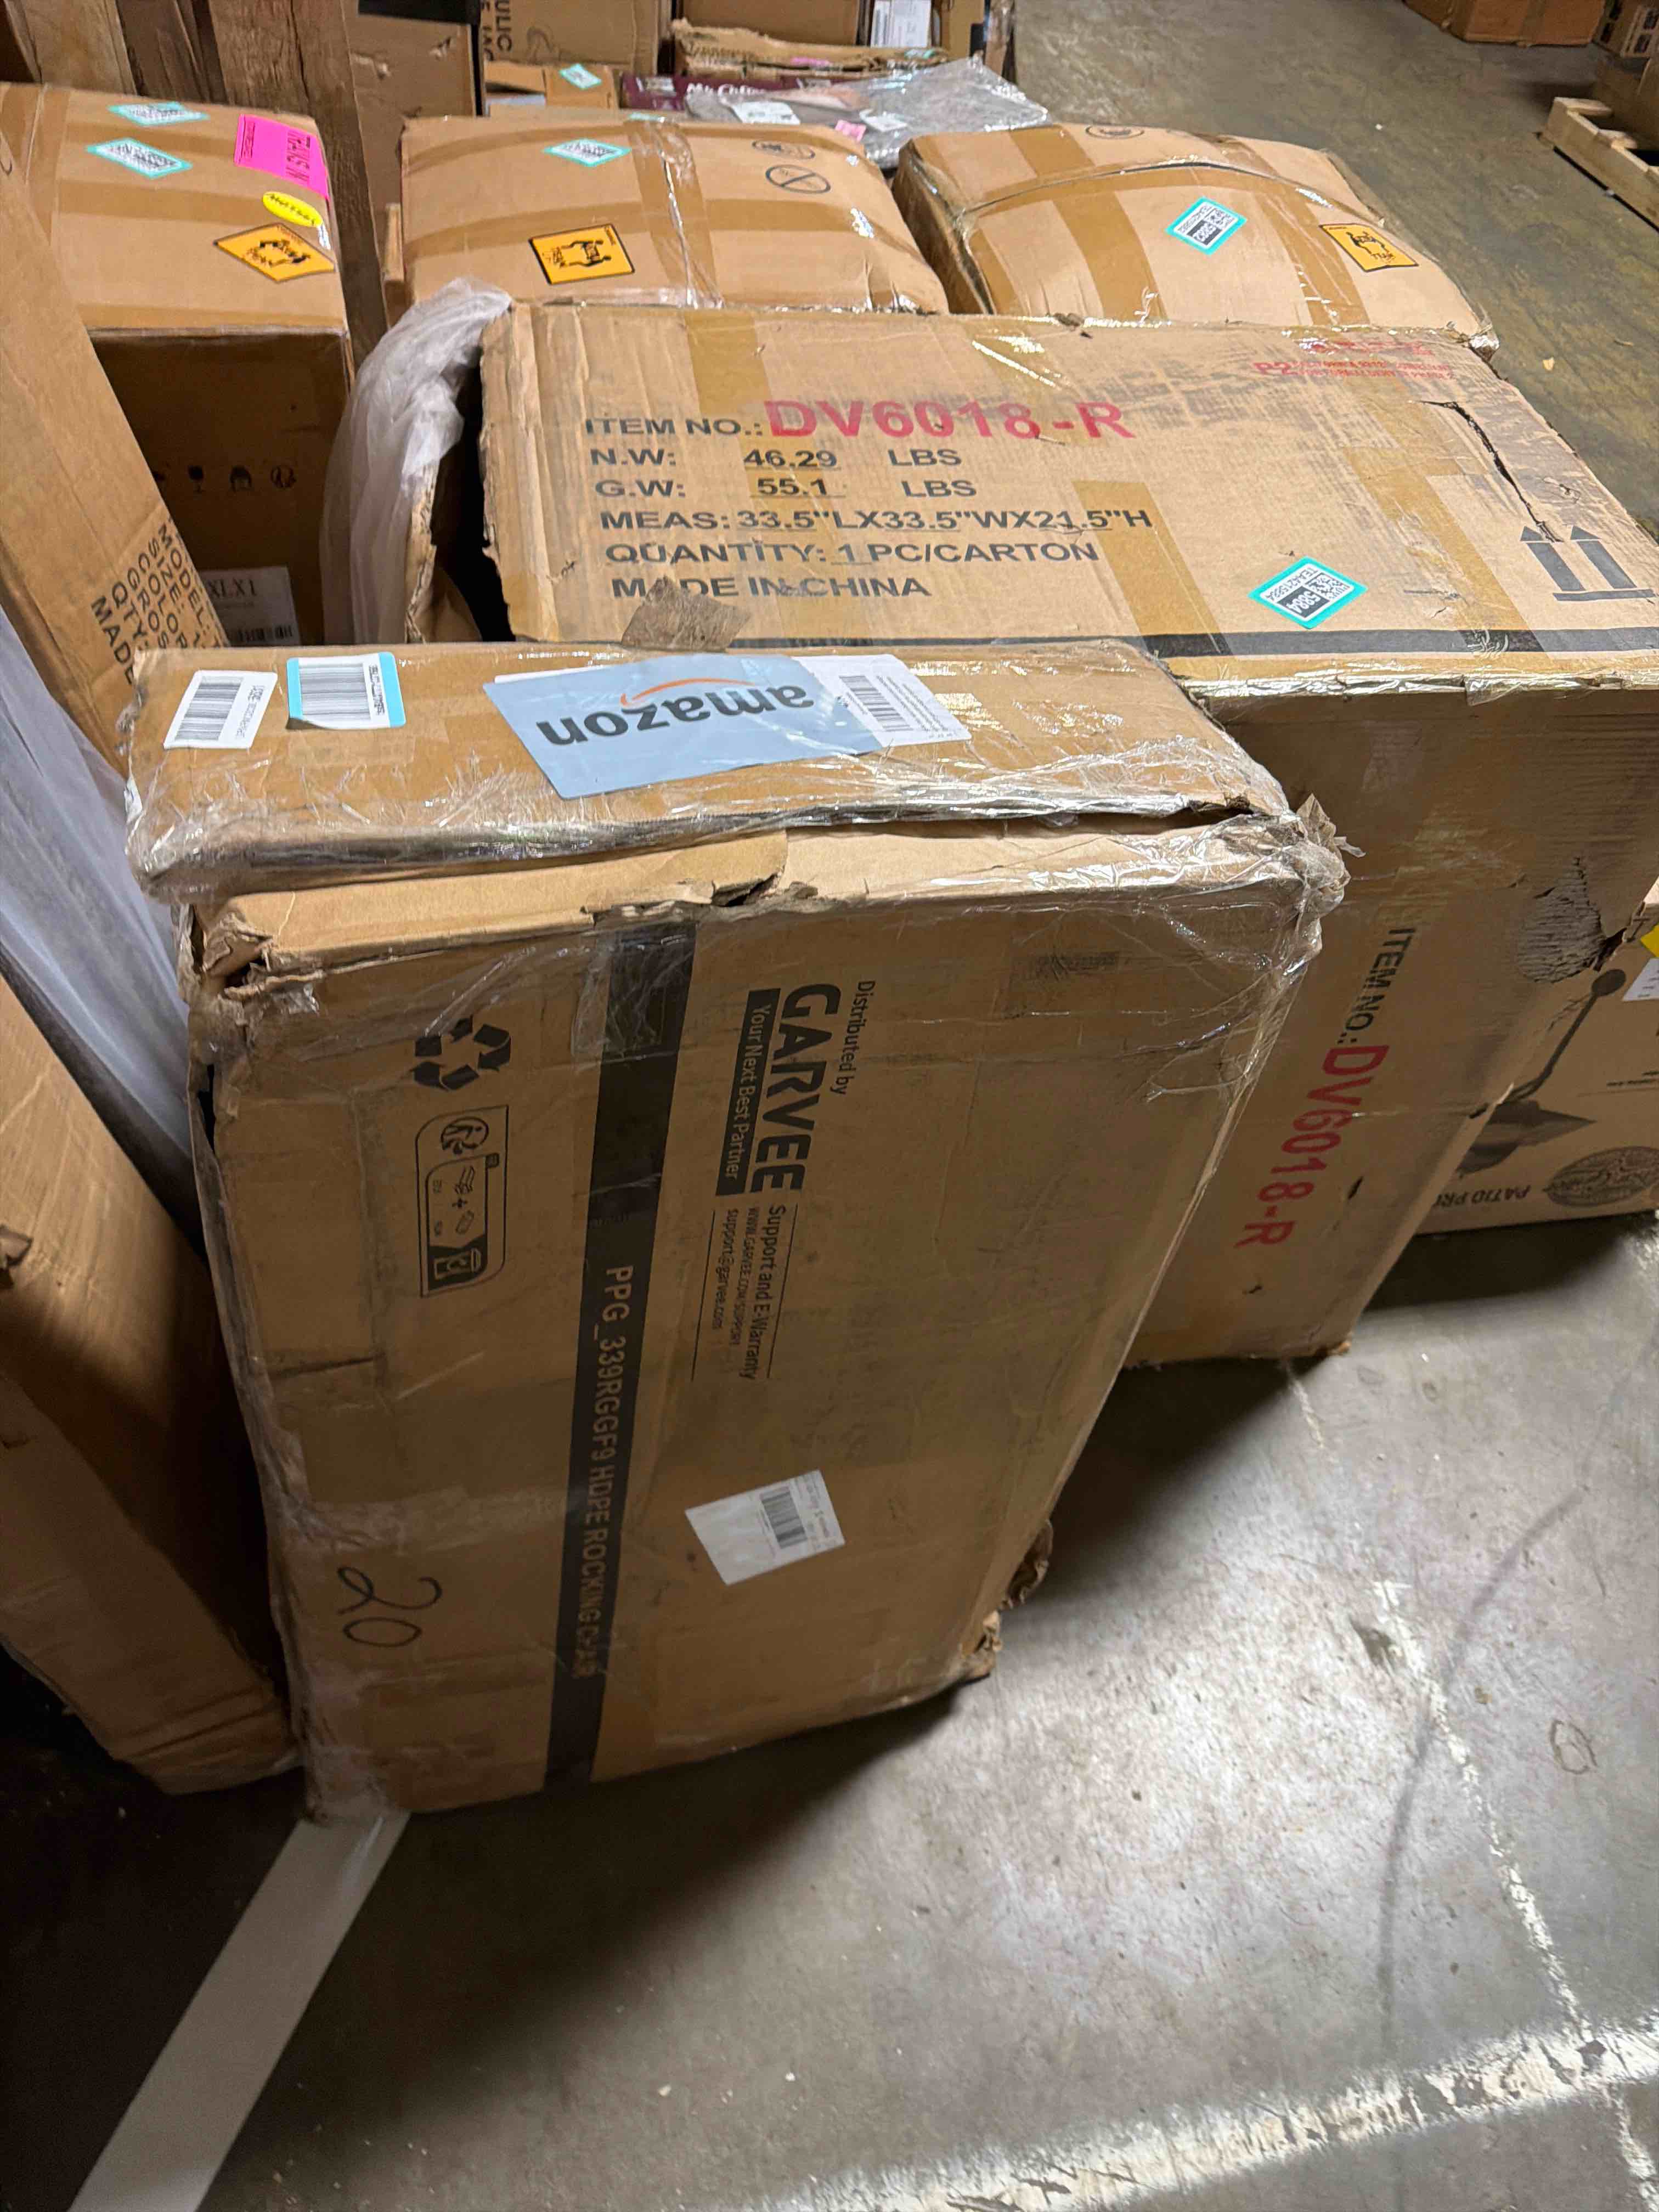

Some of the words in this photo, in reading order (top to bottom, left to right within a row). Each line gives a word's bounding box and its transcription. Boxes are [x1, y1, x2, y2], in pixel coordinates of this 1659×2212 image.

[586, 418, 675, 436] ITEM
[686, 418, 763, 436] NO.:
[764, 400, 1136, 438] DV6018-R
[590, 448, 676, 466] N.W:
[744, 449, 837, 467] 46.29
[887, 449, 962, 466] LBS
[595, 479, 685, 498] G.W:
[757, 478, 828, 496] 55.1
[901, 480, 977, 498] LBS
[600, 511, 730, 530] MEAS:
[148, 537, 185, 615] SIZE:
[159, 523, 211, 636] MODEL:
[606, 543, 826, 564] QUANTITY:
[837, 544, 857, 563] 1
[611, 577, 739, 598] MDE
[748, 576, 791, 597] IN
[800, 576, 932, 597] CHINA
[1286, 590, 1321, 614] 5884
[535, 685, 815, 746] amazon
[1363, 928, 1417, 989] ITEM
[747, 1005, 771, 1044] Your
[838, 980, 876, 1073] Distributed
[1337, 994, 1386, 1044] NO.:
[741, 1046, 763, 1085] Next
[749, 983, 842, 1194] GARVEE
[830, 1075, 855, 1096] by
[733, 1087, 757, 1121] Best
[725, 1122, 750, 1182] Partner
[1233, 1045, 1390, 1249] DV6018-R
[759, 1204, 786, 1270] Support
[755, 1272, 773, 1300] and
[738, 1302, 771, 1380] E-Warranty
[586, 1465, 615, 1525] HDPE
[578, 1528, 608, 1623] ROCKING
[336, 1566, 443, 1647] 20
